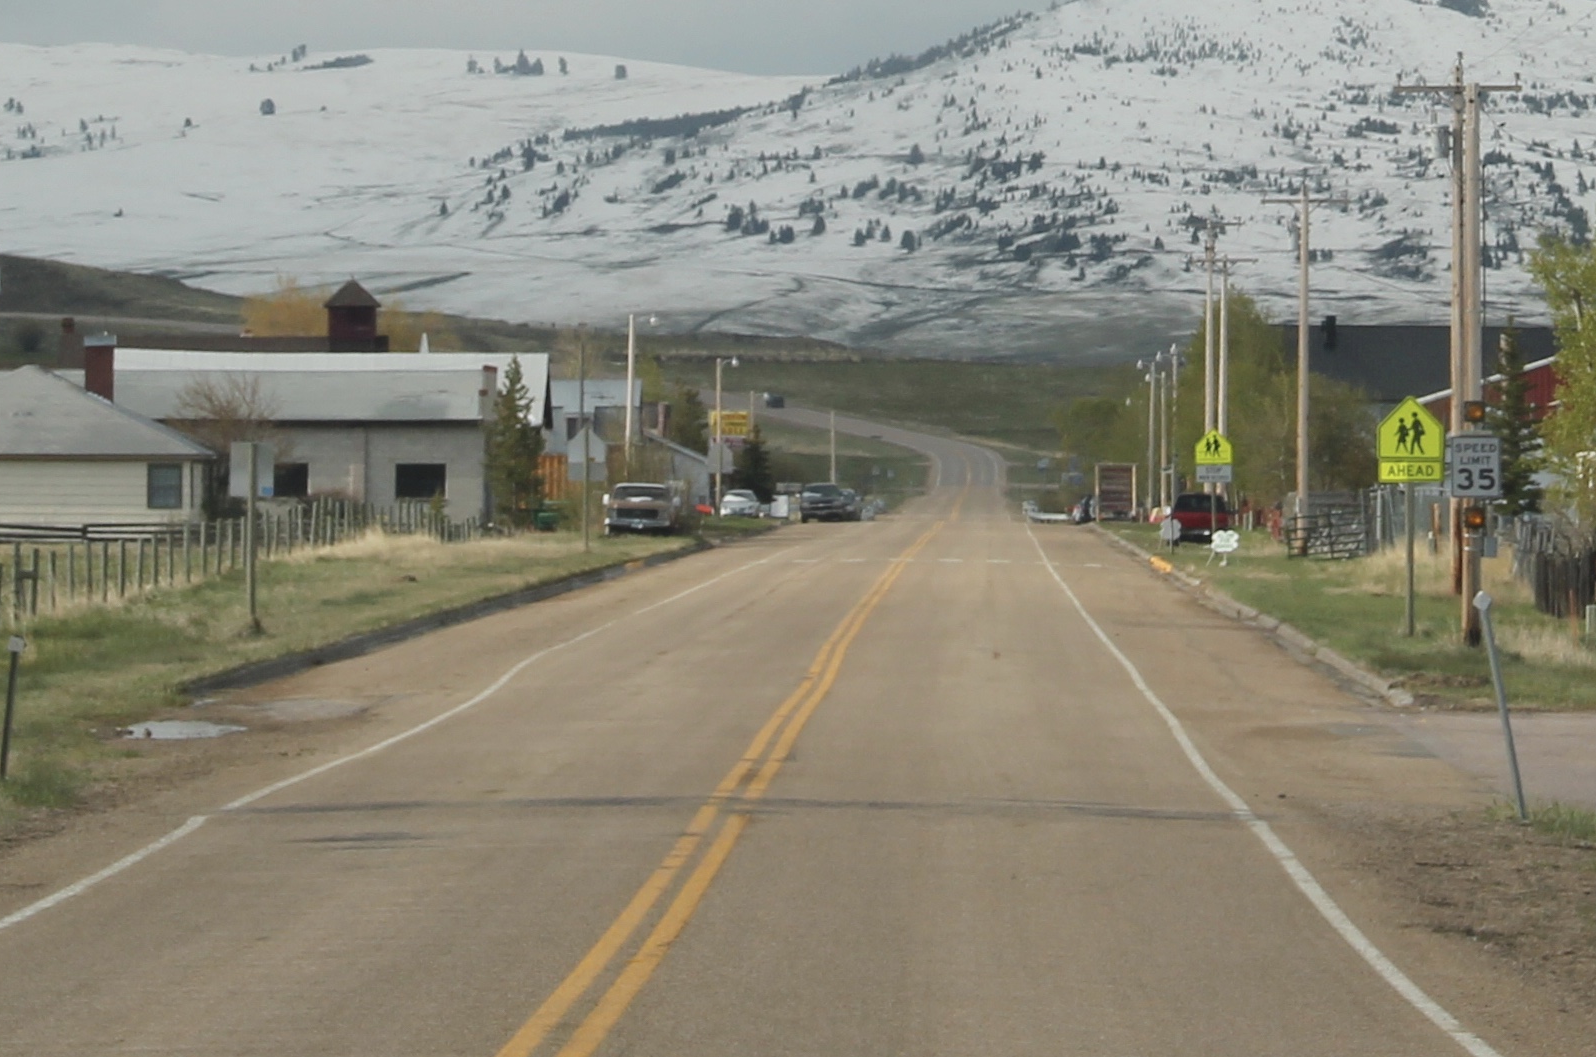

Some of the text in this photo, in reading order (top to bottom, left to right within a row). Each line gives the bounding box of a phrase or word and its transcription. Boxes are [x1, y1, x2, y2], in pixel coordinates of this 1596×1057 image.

[1455, 443, 1497, 453] SPEED
[1460, 456, 1491, 465] LIMIT
[1388, 465, 1434, 477] AHEAD
[1458, 468, 1495, 490] 35
